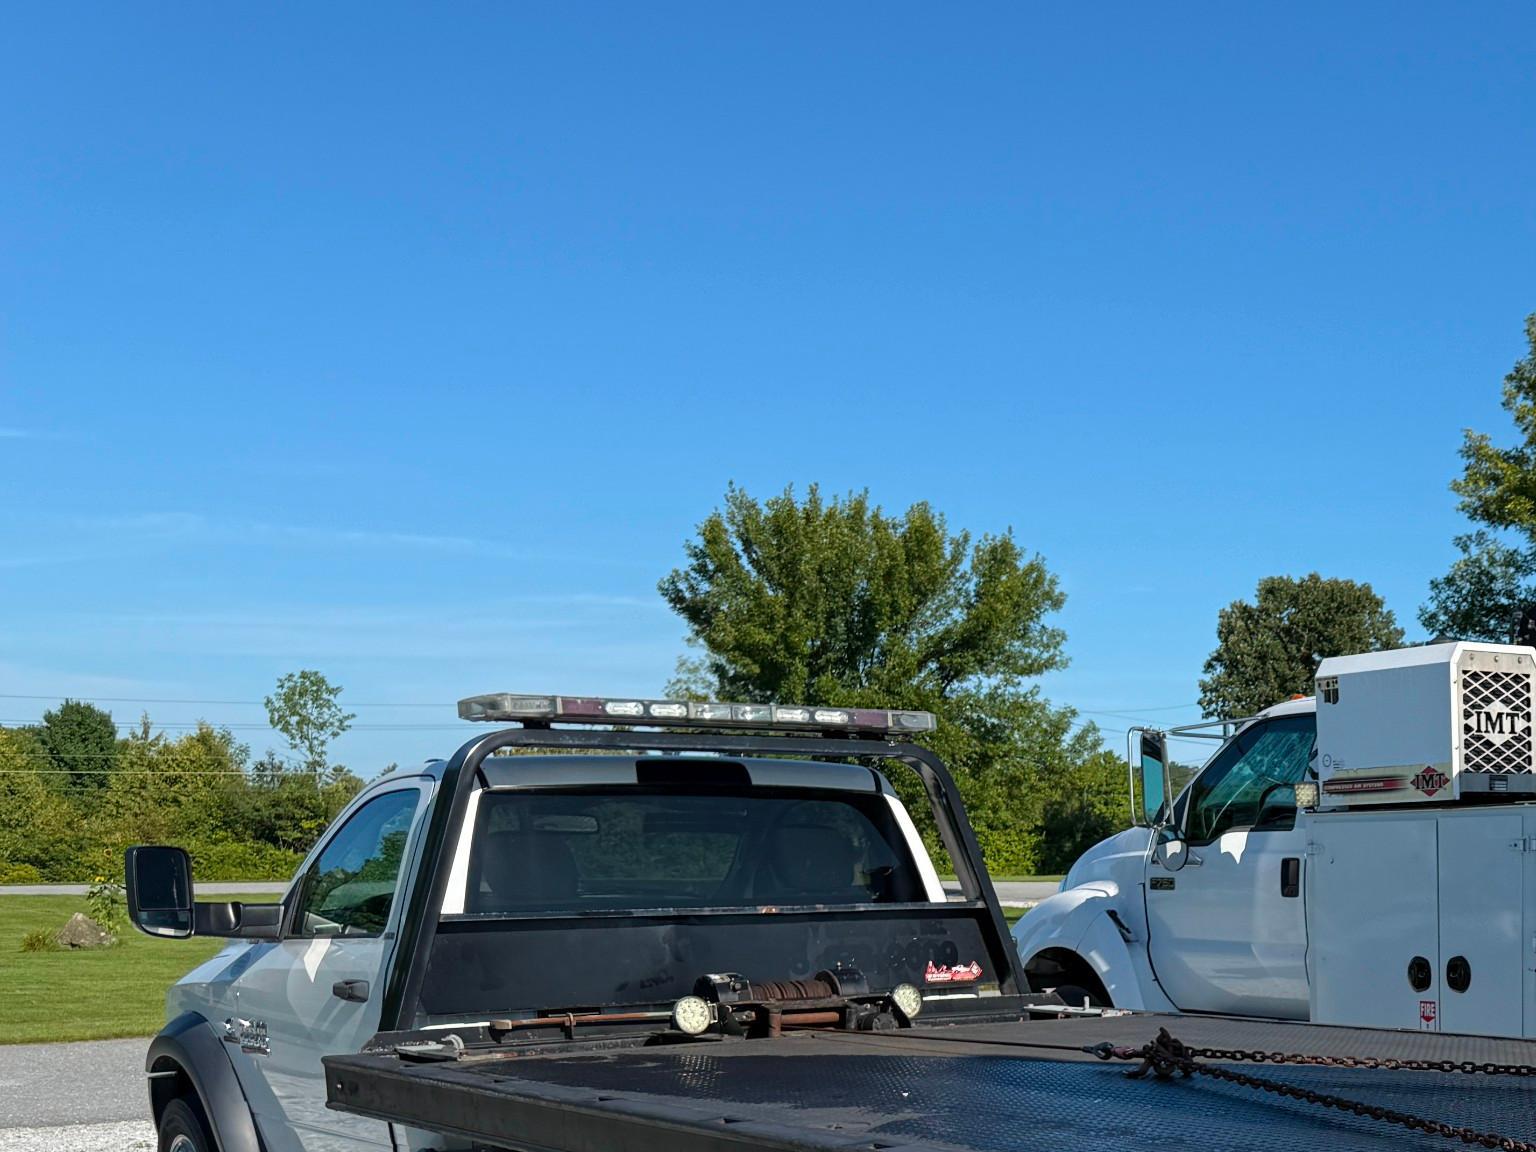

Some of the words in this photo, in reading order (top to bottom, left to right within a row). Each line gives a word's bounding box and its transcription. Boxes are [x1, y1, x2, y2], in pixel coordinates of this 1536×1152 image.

[1474, 710, 1520, 735] IMT
[1414, 773, 1445, 790] IMT
[1420, 1002, 1436, 1016] FIRE
